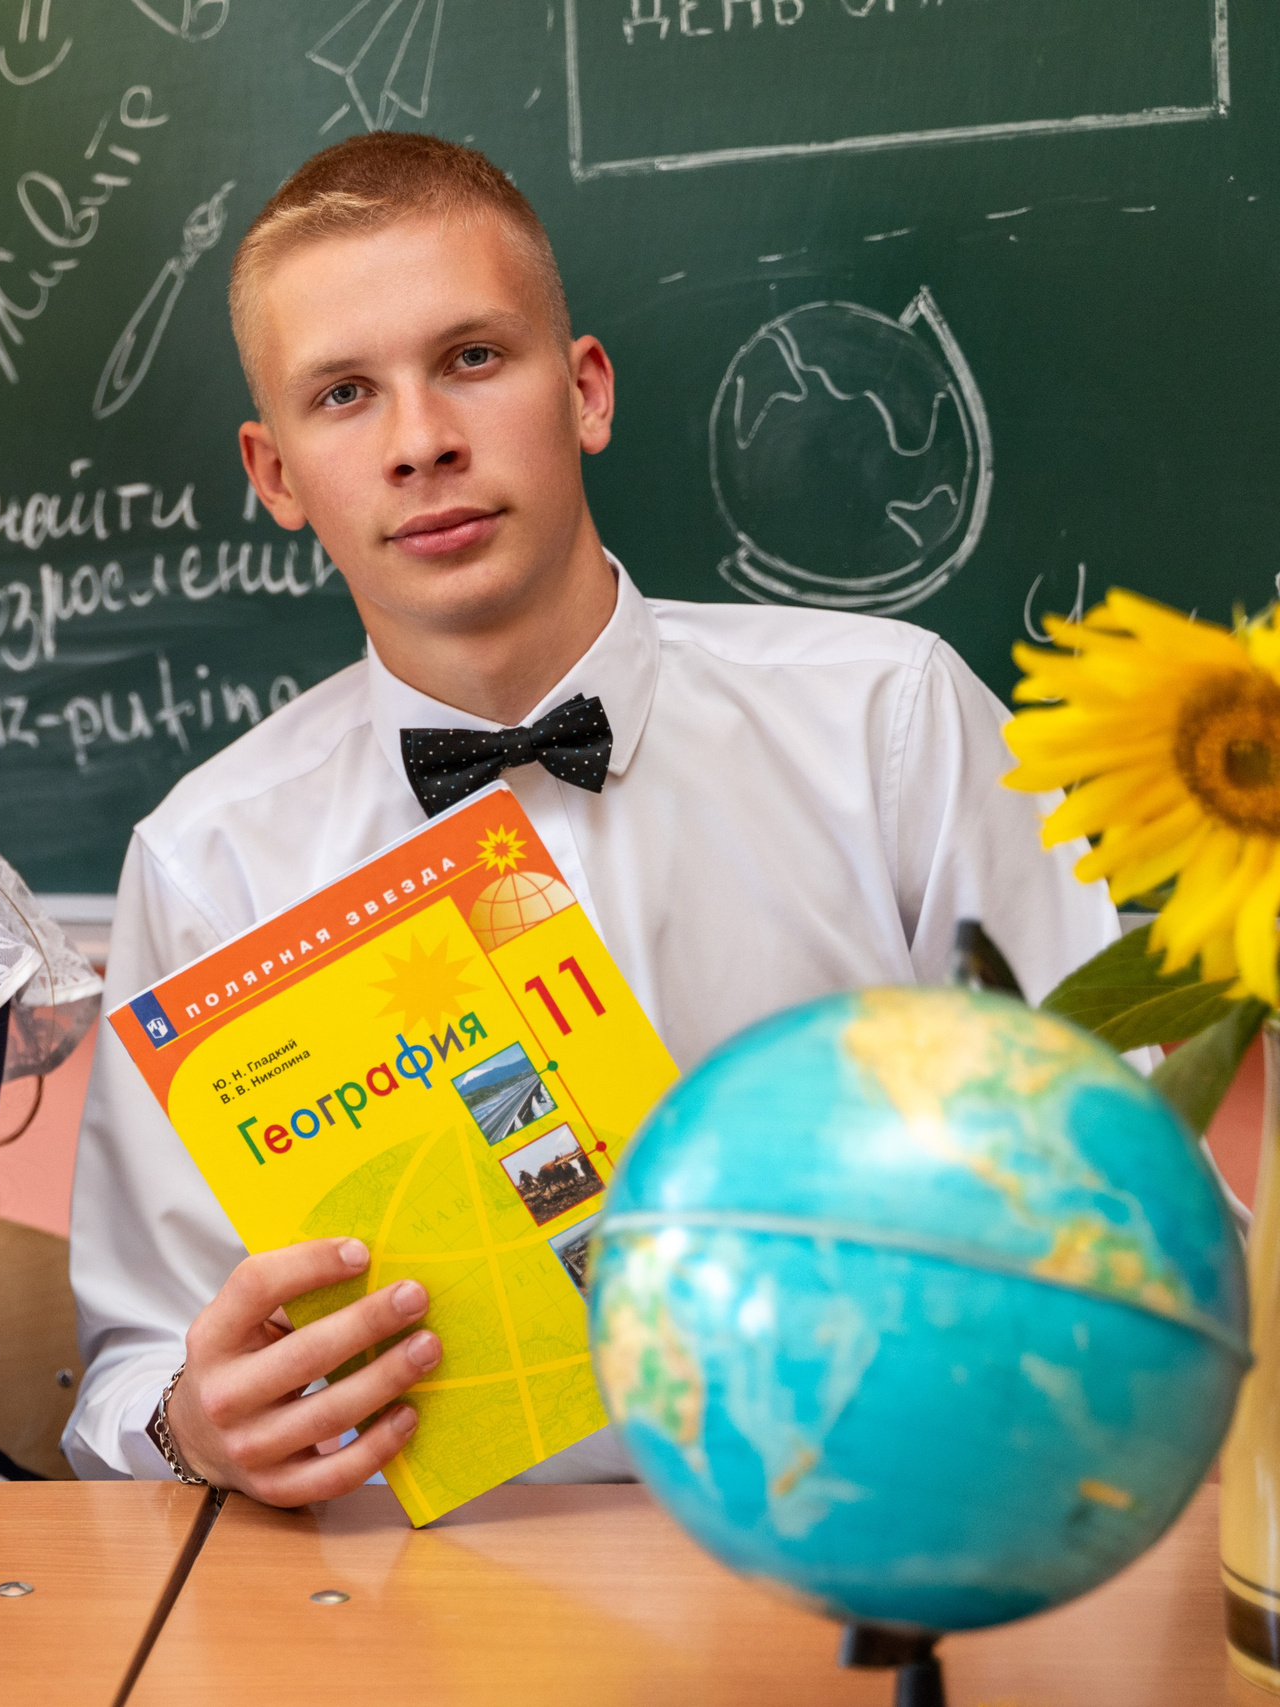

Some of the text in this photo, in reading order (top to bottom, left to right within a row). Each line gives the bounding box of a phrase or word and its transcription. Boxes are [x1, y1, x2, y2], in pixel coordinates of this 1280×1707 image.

[184, 857, 456, 1019] ПОЛЯРНАЯ ЗВЕЗДА
[523, 955, 607, 1037] 11
[212, 1038, 298, 1092] Ю. Н. Гладкий
[220, 1049, 311, 1105] В. В. Николина
[236, 1010, 489, 1166] География
